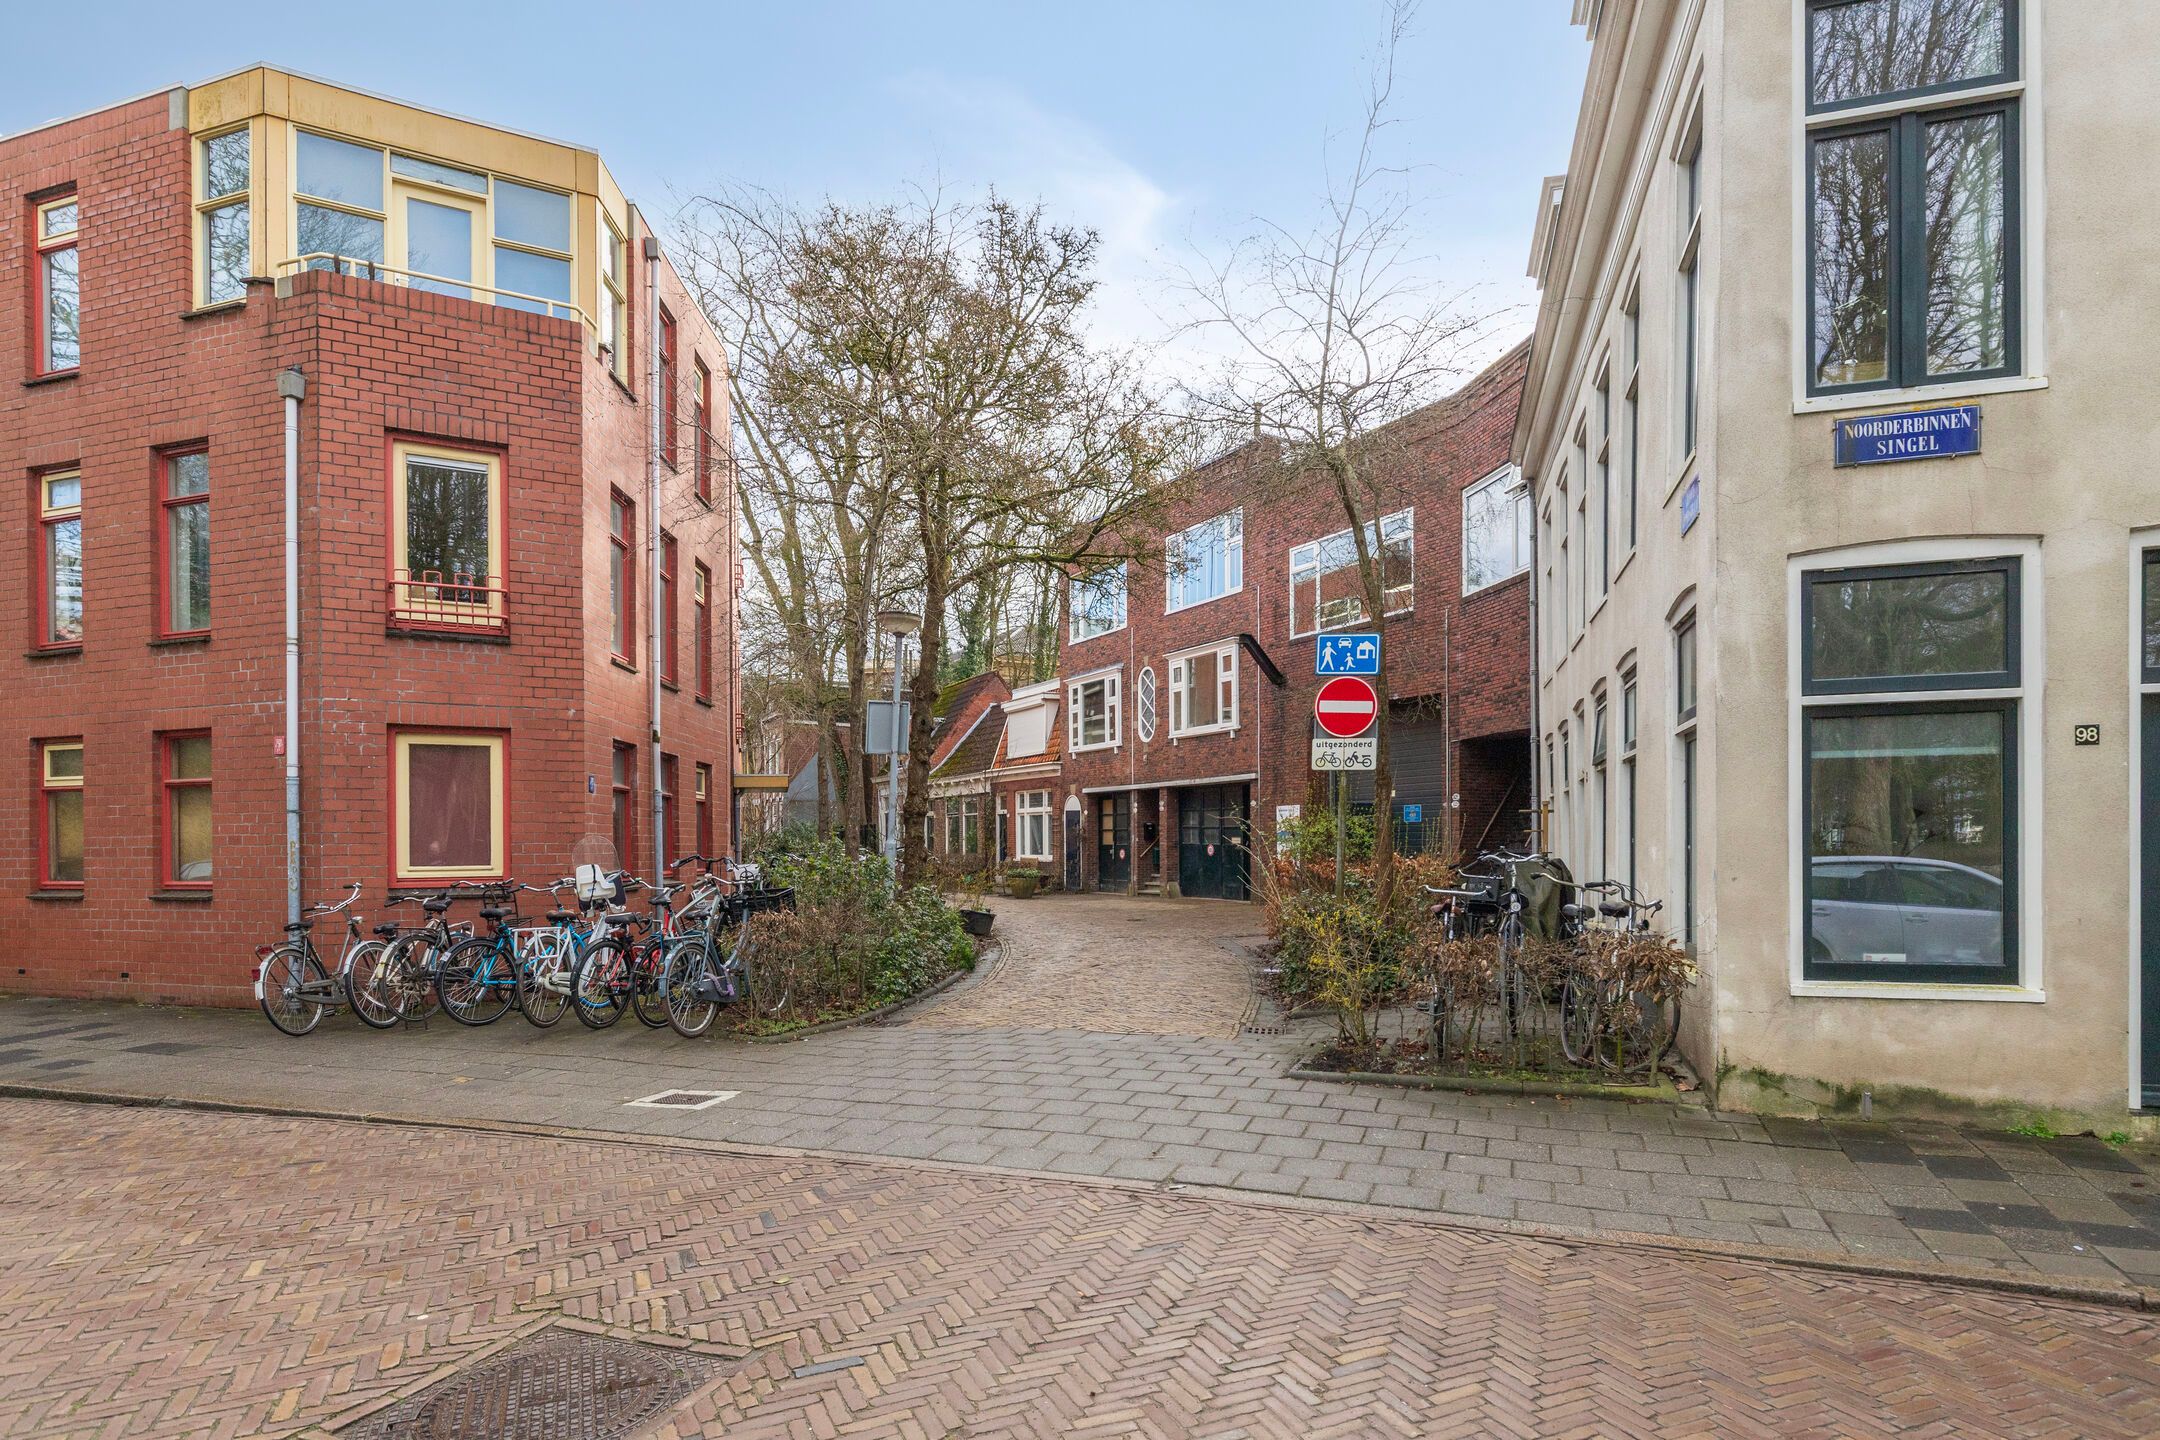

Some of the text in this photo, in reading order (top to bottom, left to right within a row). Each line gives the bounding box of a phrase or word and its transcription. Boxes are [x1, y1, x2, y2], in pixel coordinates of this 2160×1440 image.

[1844, 412, 1971, 440] NOORDERBINNEN
[1876, 435, 1939, 456] SINGEL
[2076, 727, 2098, 742] 98
[1316, 741, 1372, 749] uitgezonderd
